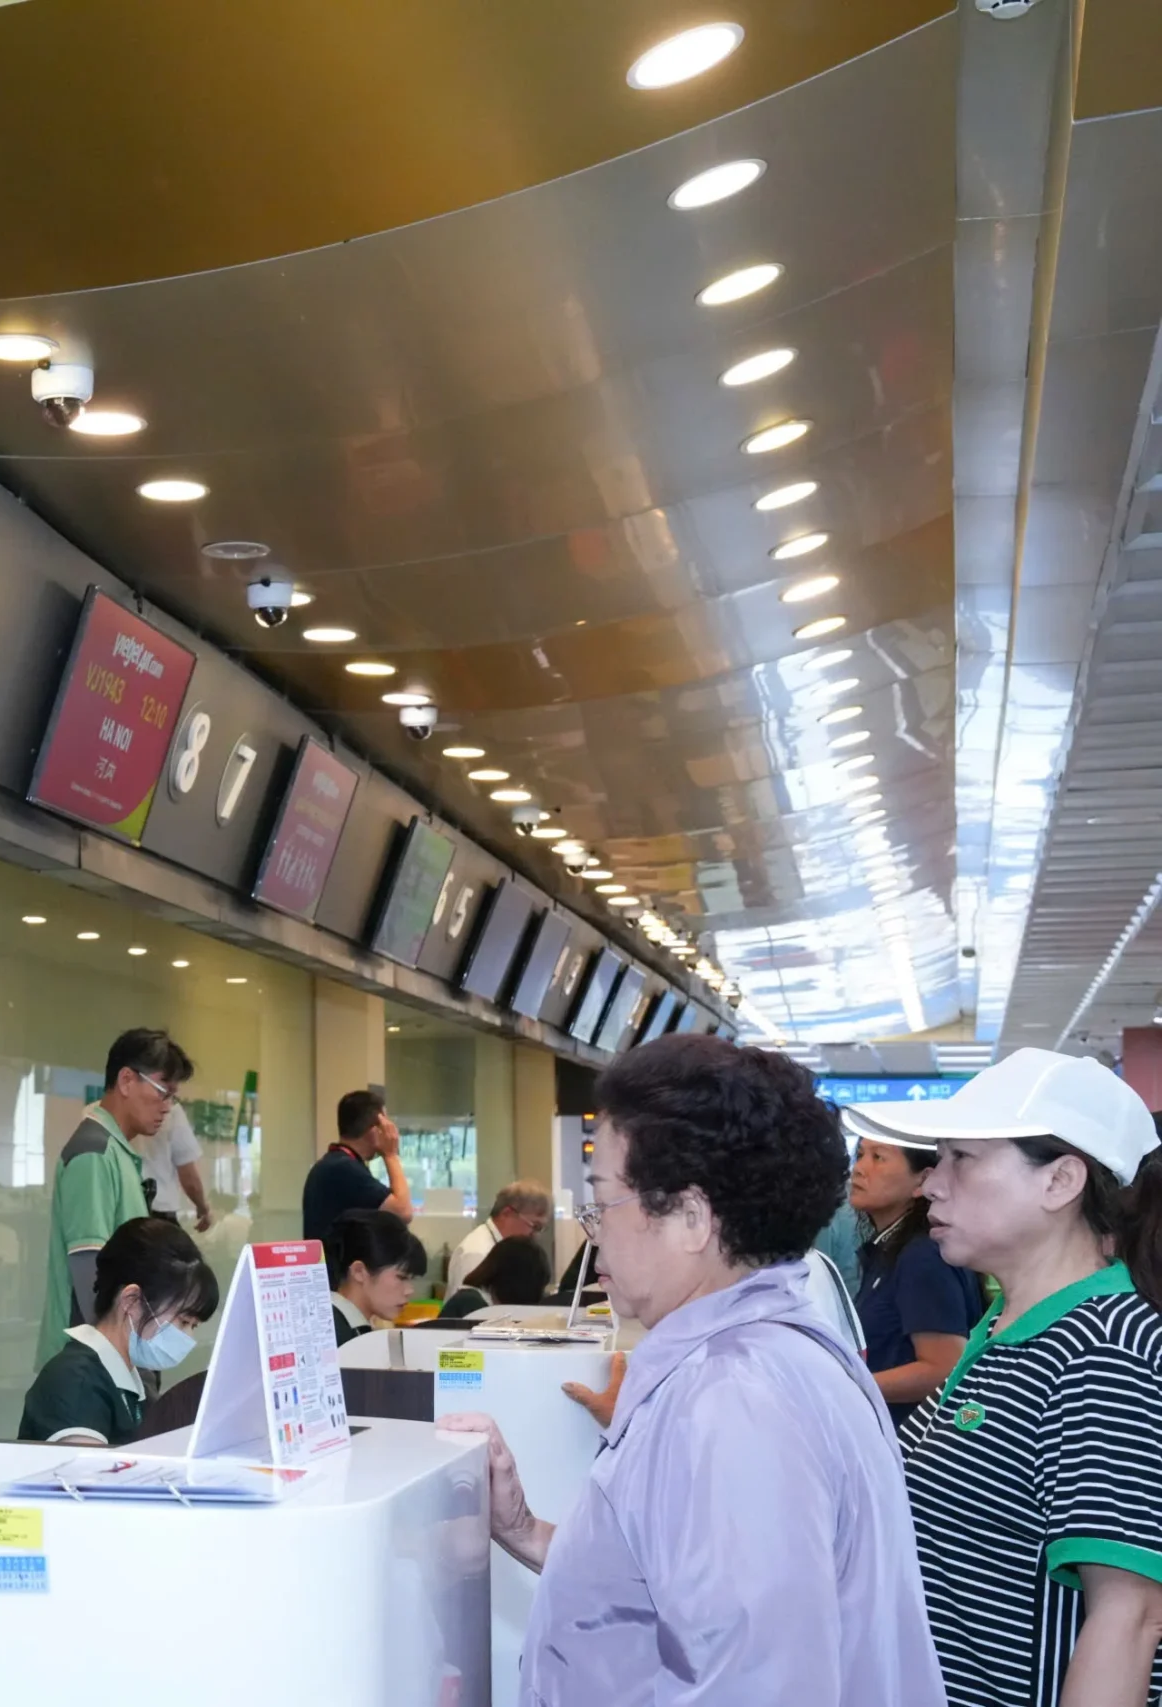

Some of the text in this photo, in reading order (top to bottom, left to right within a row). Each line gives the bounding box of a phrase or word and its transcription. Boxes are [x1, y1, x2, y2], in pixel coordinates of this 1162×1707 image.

[85, 660, 126, 706] VJ1943
[99, 715, 134, 754] HA NOI
[140, 694, 169, 731] 12:10
[176, 712, 211, 794] 8
[220, 743, 258, 820] 7
